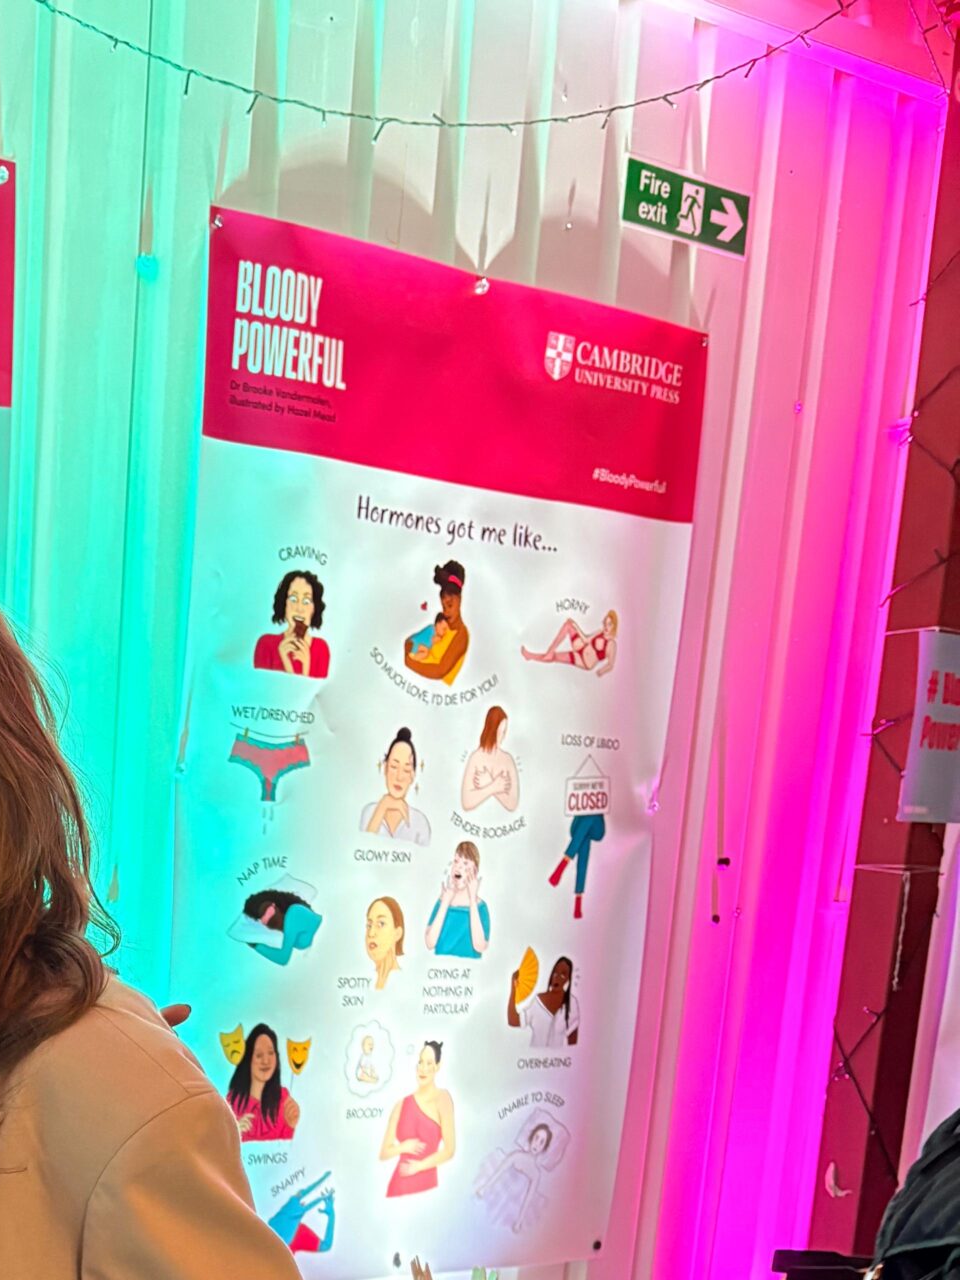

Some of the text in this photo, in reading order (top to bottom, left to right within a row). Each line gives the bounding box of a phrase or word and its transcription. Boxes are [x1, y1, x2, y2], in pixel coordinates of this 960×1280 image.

[639, 168, 671, 199] Fire
[637, 201, 668, 226] exit
[235, 259, 324, 328] BLOODY
[231, 317, 347, 391] POWERFUL
[575, 341, 684, 387] CAMBRIDGE
[574, 367, 680, 405] UNIVERSITY PRESS
[592, 467, 668, 494] #BloodyPowerful
[356, 494, 558, 553] Hormones got me like...
[278, 545, 328, 566] CRAVING
[555, 598, 590, 615] HORNY
[370, 646, 384, 665] SO
[381, 661, 407, 691] MUCH
[459, 687, 478, 704] FOR
[231, 704, 315, 725] WET/DRENCHED
[561, 733, 582, 747] LOSS
[583, 735, 595, 748] OF
[568, 791, 608, 812] CLOSED
[353, 848, 411, 863] GLOWY SKIN
[236, 855, 288, 887] NAP TIME
[337, 976, 372, 989] SPOTTY
[427, 967, 472, 981] CRYING AT
[342, 995, 365, 1008] SKIN
[422, 985, 474, 998] NOTHING IN
[423, 1002, 470, 1015] PARTICULAR
[516, 1056, 573, 1070] OVERHEATING
[345, 1106, 384, 1120] BROODY
[497, 1093, 530, 1121] UNABLE
[530, 1090, 543, 1104] TO
[247, 1151, 289, 1166] SWINGS
[270, 1166, 307, 1198] SNAPPY
